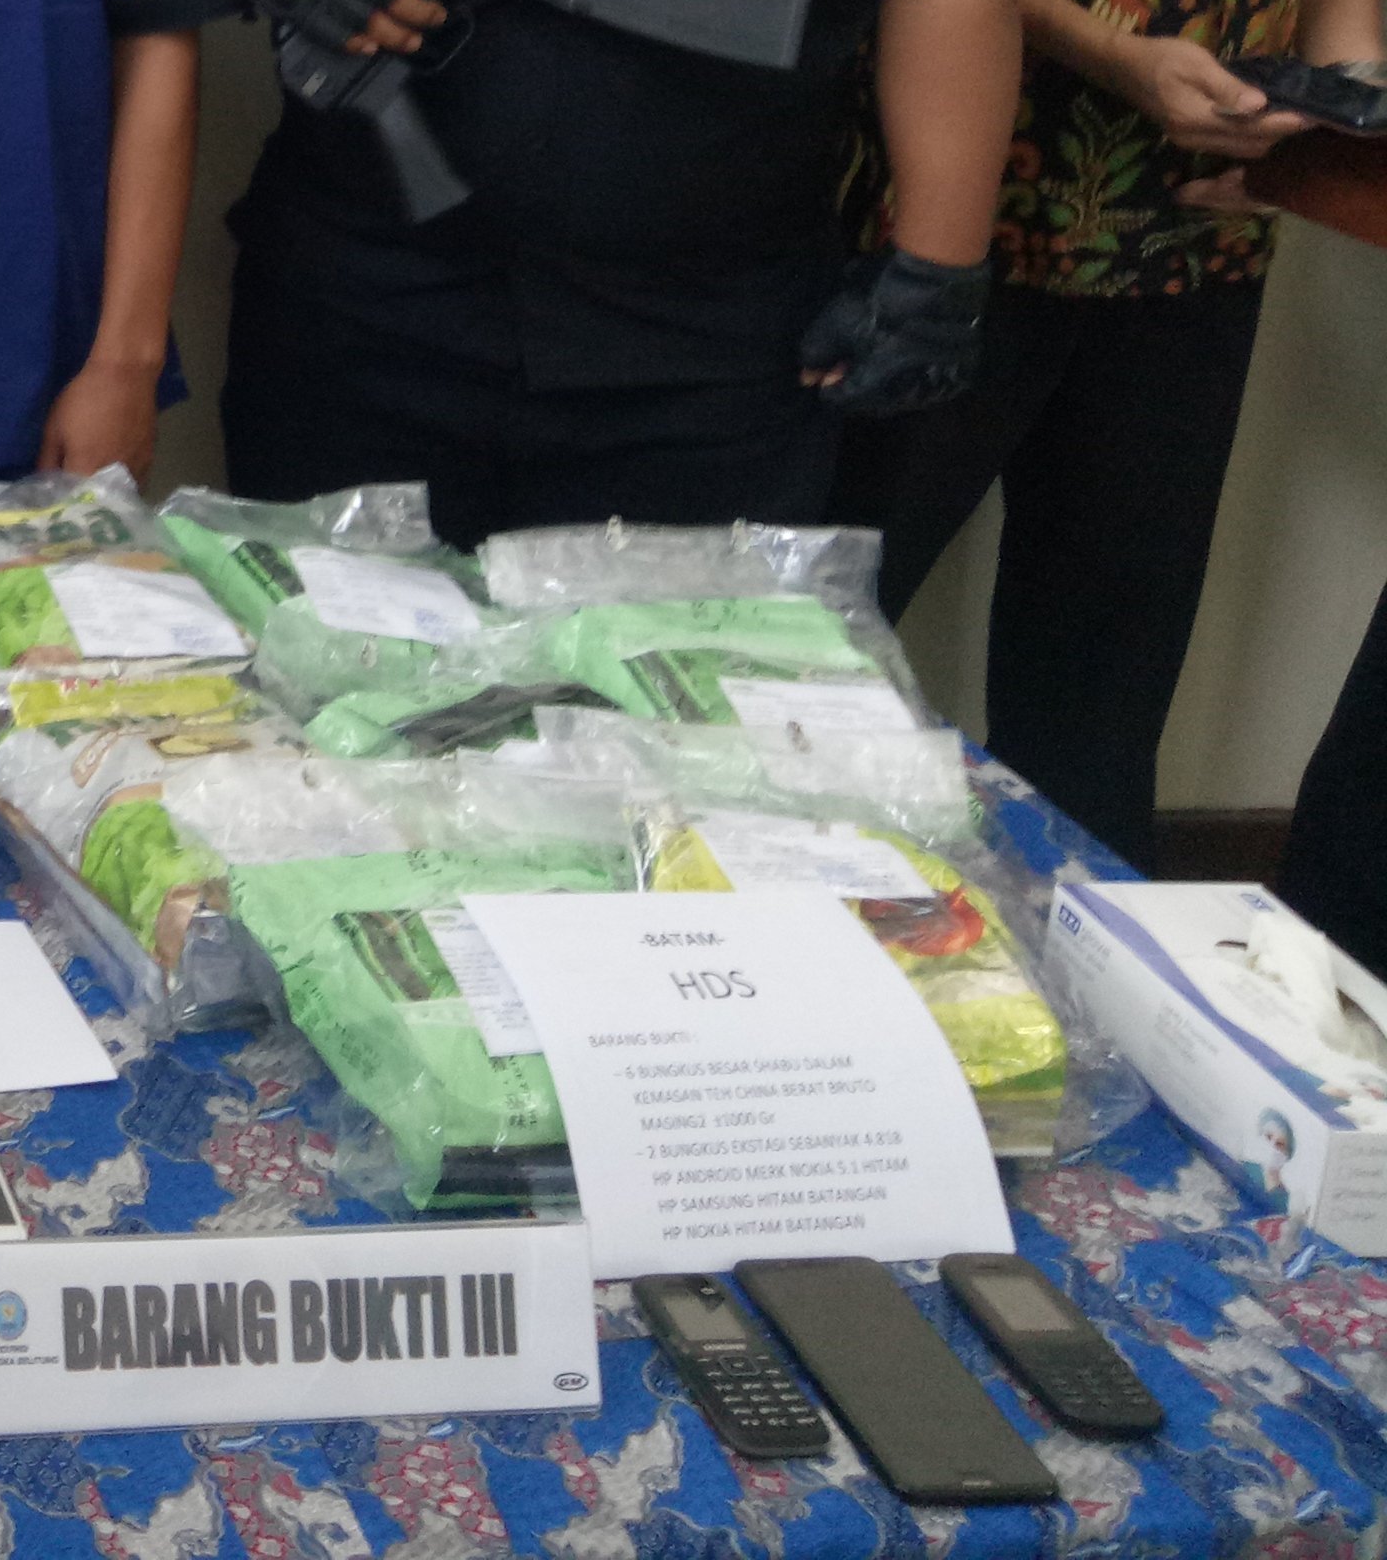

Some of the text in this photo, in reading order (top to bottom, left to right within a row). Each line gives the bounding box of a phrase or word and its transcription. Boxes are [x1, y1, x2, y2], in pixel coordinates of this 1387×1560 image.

[669, 969, 758, 1001] HDS
[588, 1033, 648, 1048] BARANG
[636, 1063, 707, 1079] BUNGKUS
[708, 1061, 752, 1077] BESAR
[753, 1059, 802, 1074] SHABU
[633, 1089, 703, 1106] KEMASAN
[781, 1082, 825, 1097] BERAT
[827, 1079, 877, 1095] BRUTO
[659, 1141, 729, 1158] BUNGKUS
[652, 1171, 672, 1186] HP
[677, 1167, 743, 1185] ANDROID
[744, 1164, 786, 1181] MERK
[789, 1161, 833, 1178] NOKIA
[863, 1156, 910, 1173] HITAM
[658, 1186, 888, 1213] HP SAMSUNG HITAM BATANGAN
[662, 1214, 866, 1240] HP NOKIA HITAM BATANGAN
[61, 1272, 518, 1371] BARANG BUKTI III
